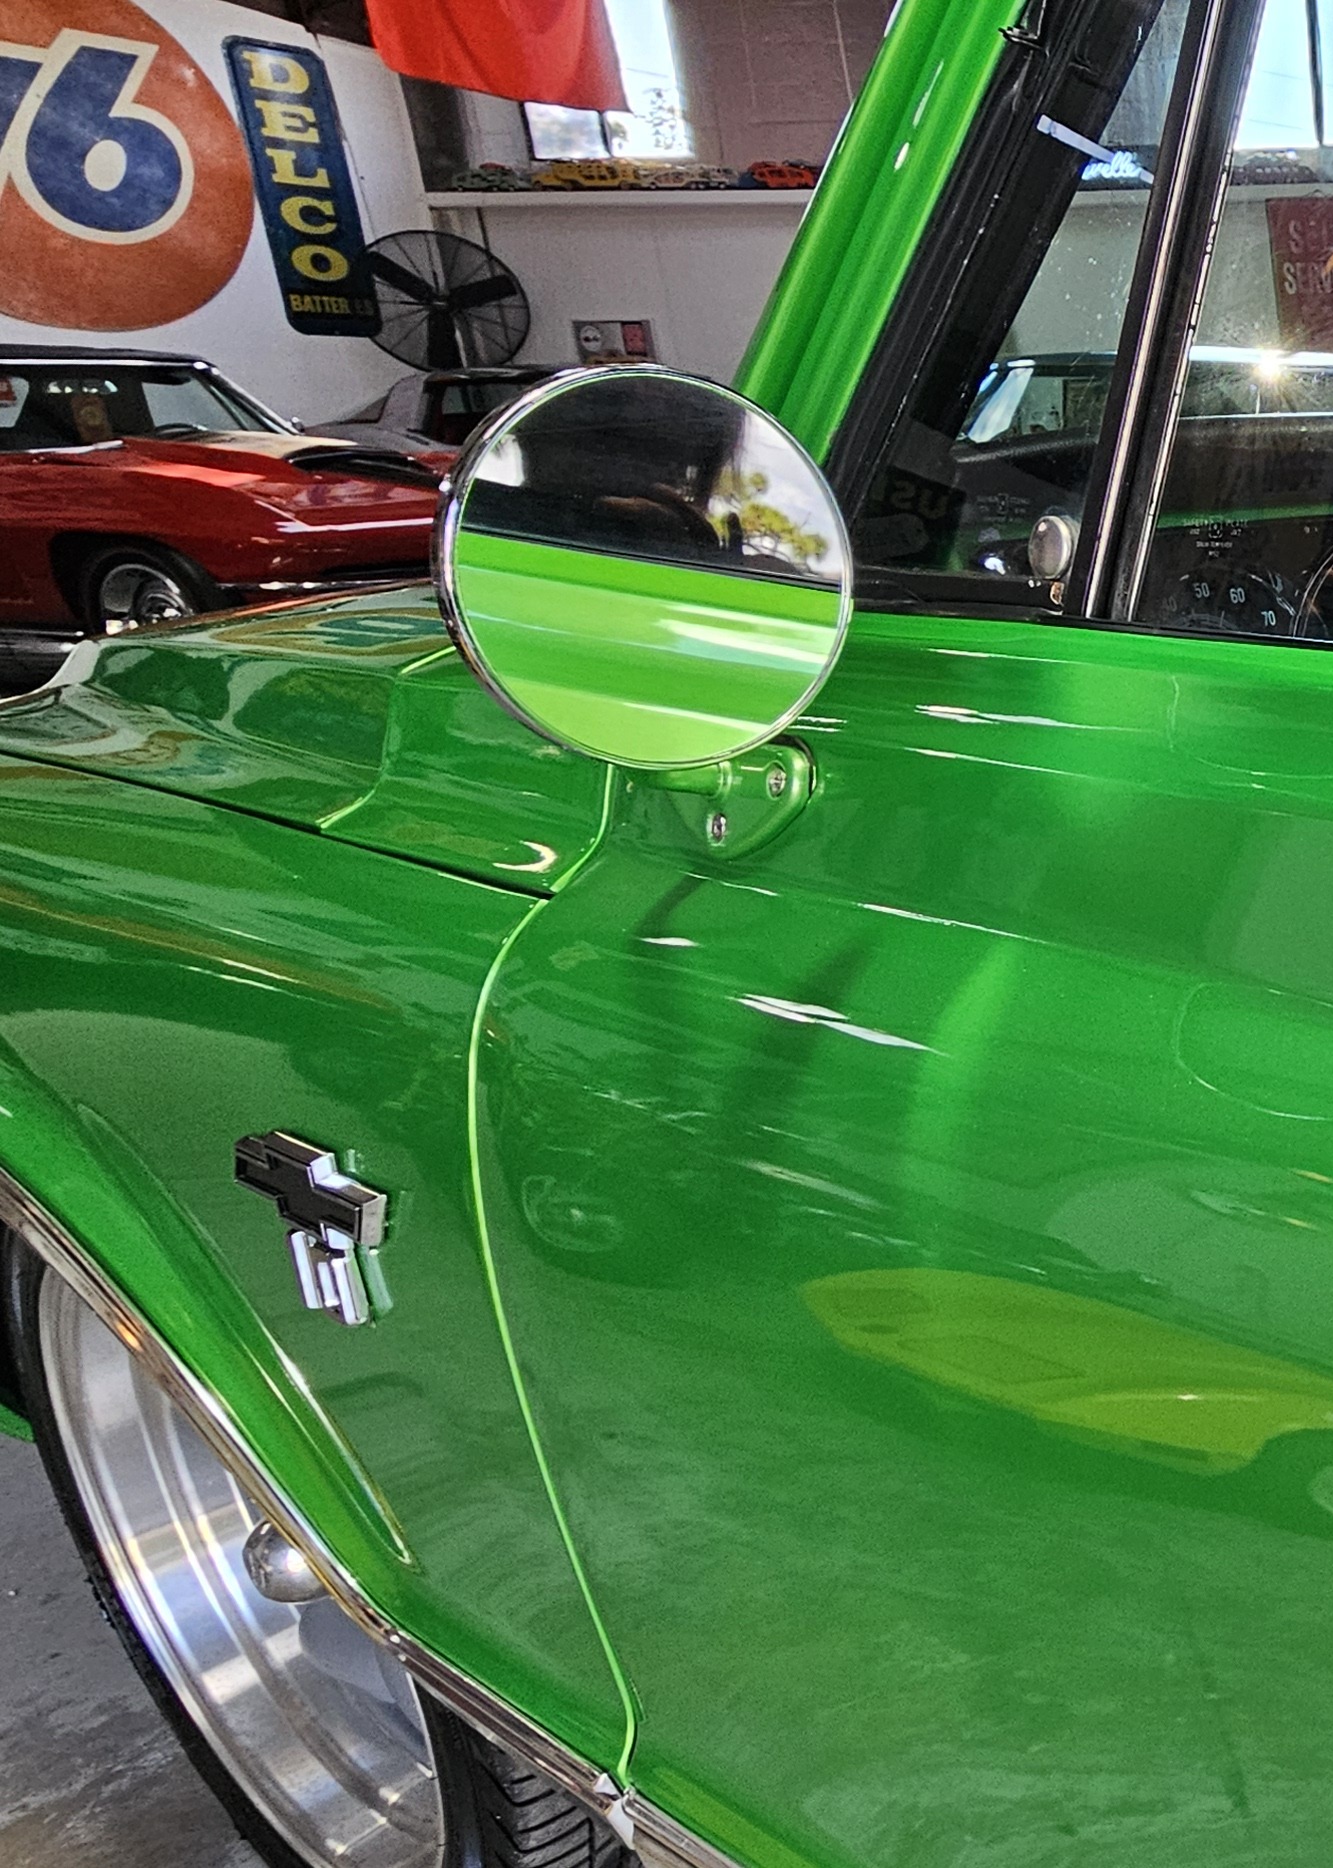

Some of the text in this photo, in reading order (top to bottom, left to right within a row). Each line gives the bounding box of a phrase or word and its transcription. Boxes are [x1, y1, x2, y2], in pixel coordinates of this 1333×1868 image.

[241, 50, 349, 282] DELCO
[288, 293, 375, 317] BATTERES
[1192, 582, 1211, 599] 50
[1229, 586, 1246, 605] 60
[1260, 609, 1277, 627] 70
